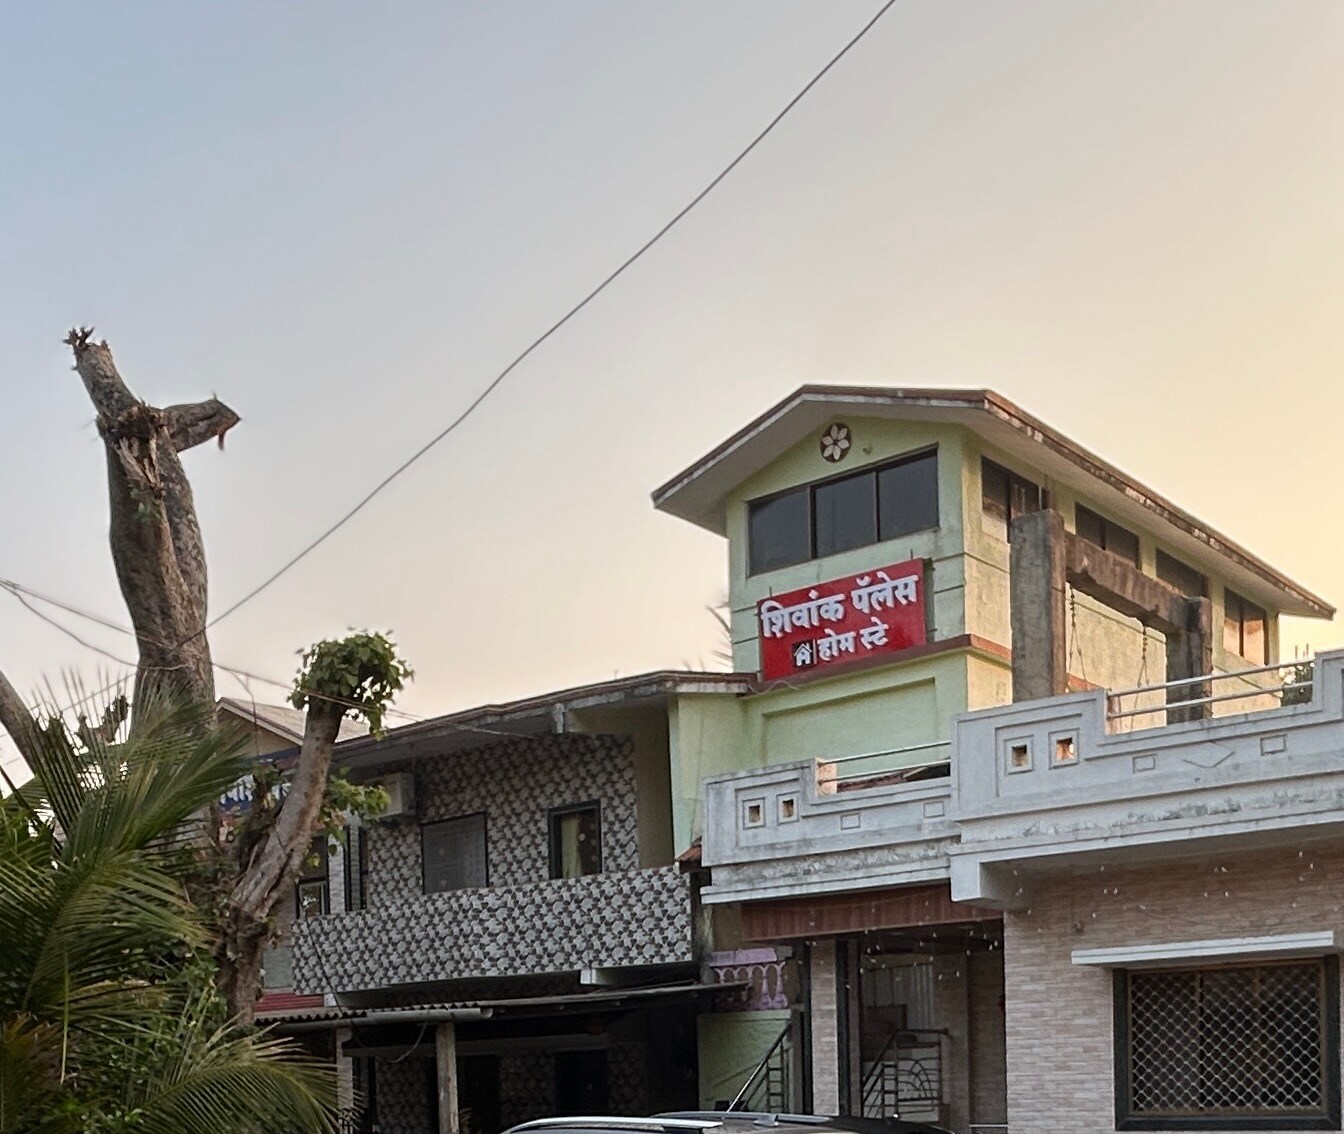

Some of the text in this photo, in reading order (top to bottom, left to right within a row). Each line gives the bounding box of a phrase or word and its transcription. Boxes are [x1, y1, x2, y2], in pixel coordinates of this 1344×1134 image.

[760, 571, 919, 638] शिवांक पॅलेस
[816, 616, 889, 661] होम स्टे
